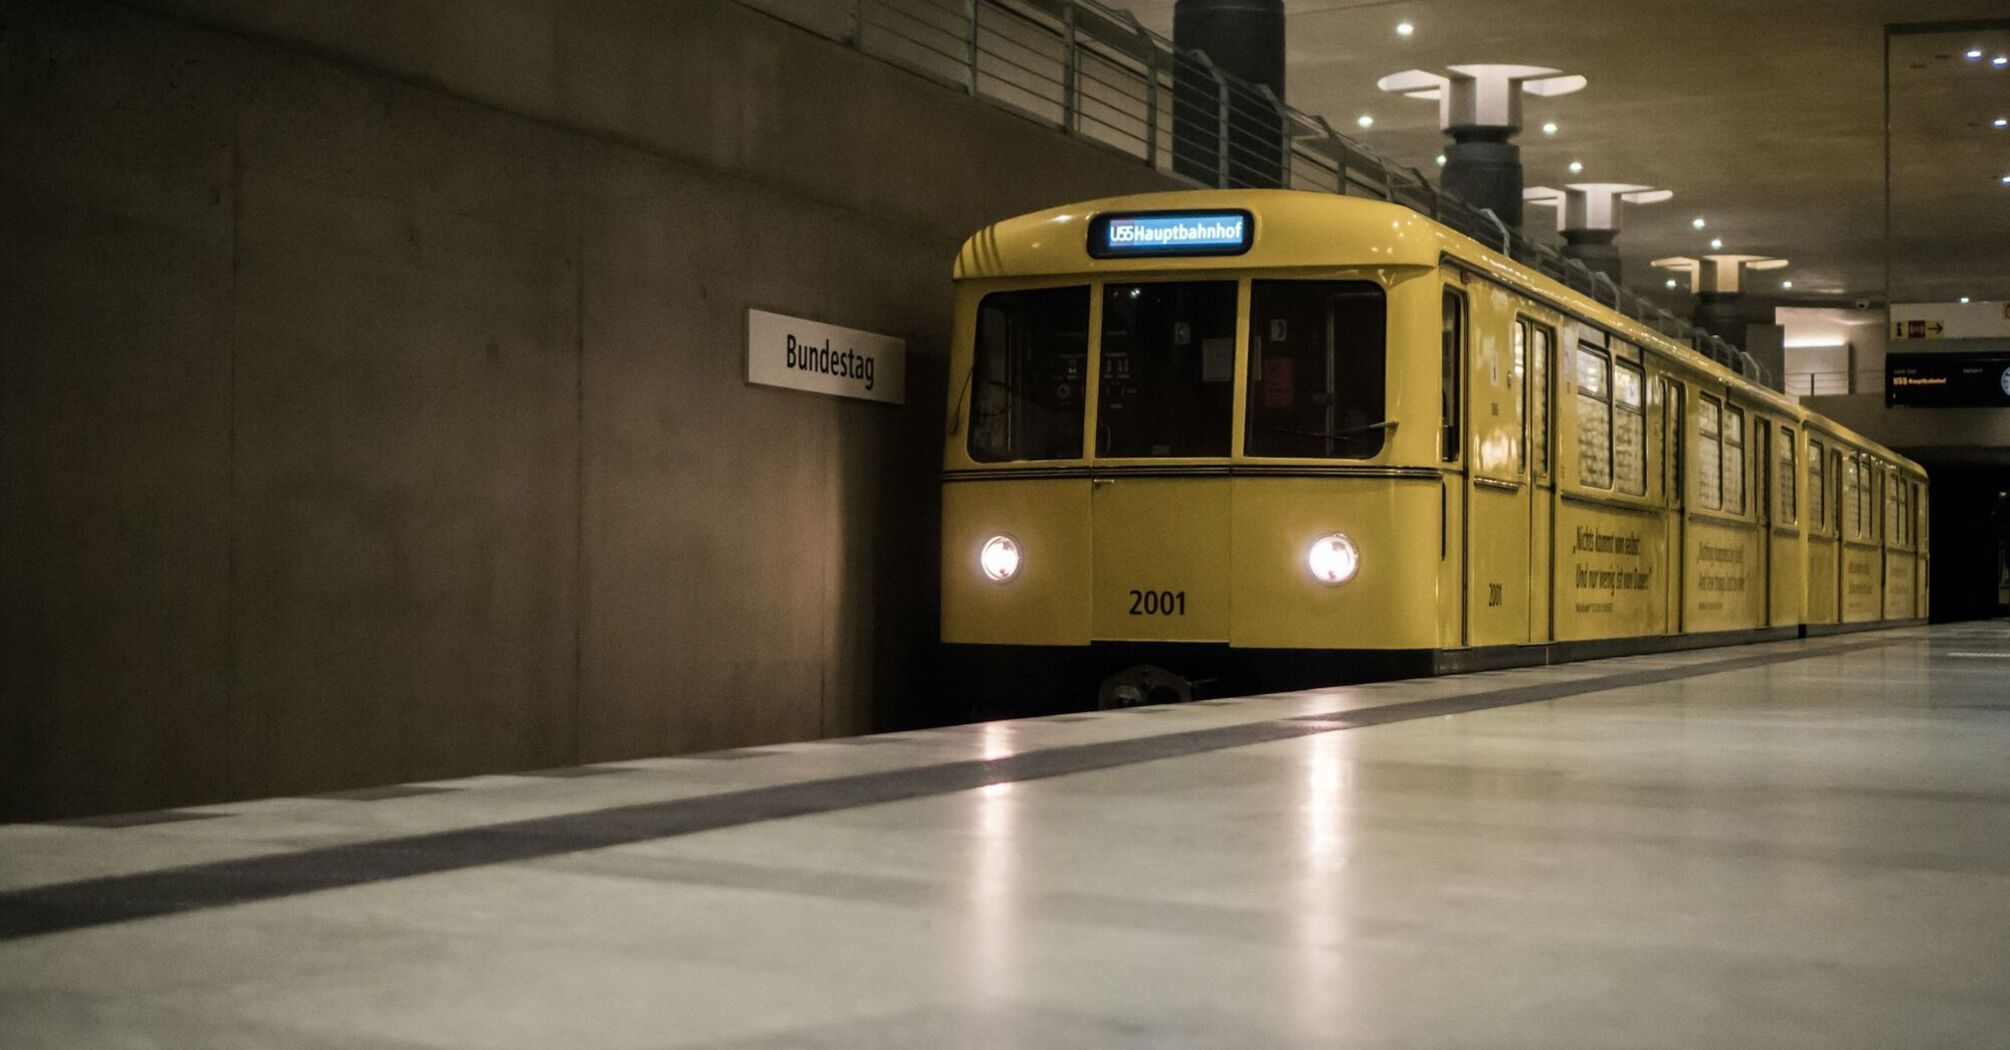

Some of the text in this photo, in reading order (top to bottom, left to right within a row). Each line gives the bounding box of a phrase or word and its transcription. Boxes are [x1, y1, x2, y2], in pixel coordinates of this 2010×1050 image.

[1110, 221, 1243, 245] U55 Hauptbahnhof
[786, 333, 875, 391] Bundestag
[1576, 562, 1588, 589] Und
[1128, 589, 1186, 616] 2001
[1488, 583, 1503, 608] 2001
